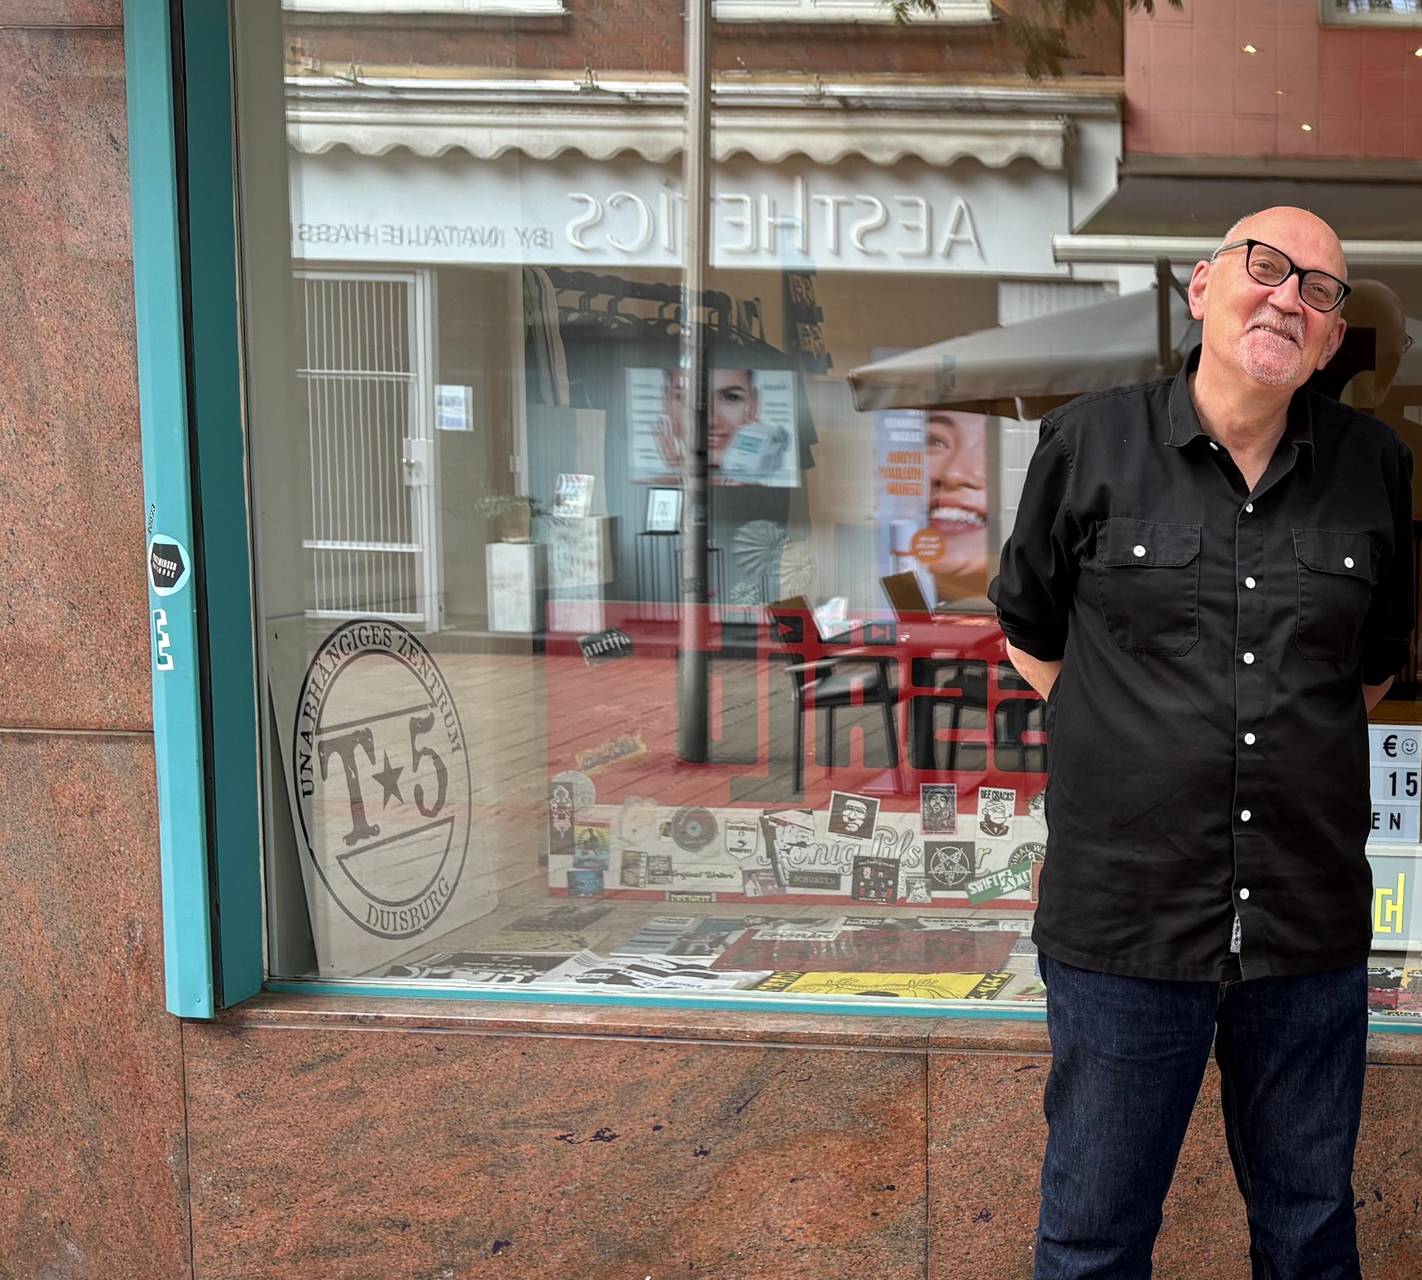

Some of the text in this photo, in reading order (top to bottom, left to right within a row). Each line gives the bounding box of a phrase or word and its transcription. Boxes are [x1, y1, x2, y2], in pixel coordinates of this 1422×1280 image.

[301, 623, 392, 799] UNABHÄNGIGES
[397, 634, 462, 754] ZENTRUM
[1389, 771, 1418, 797] 15
[365, 875, 451, 933] DUISBURG
